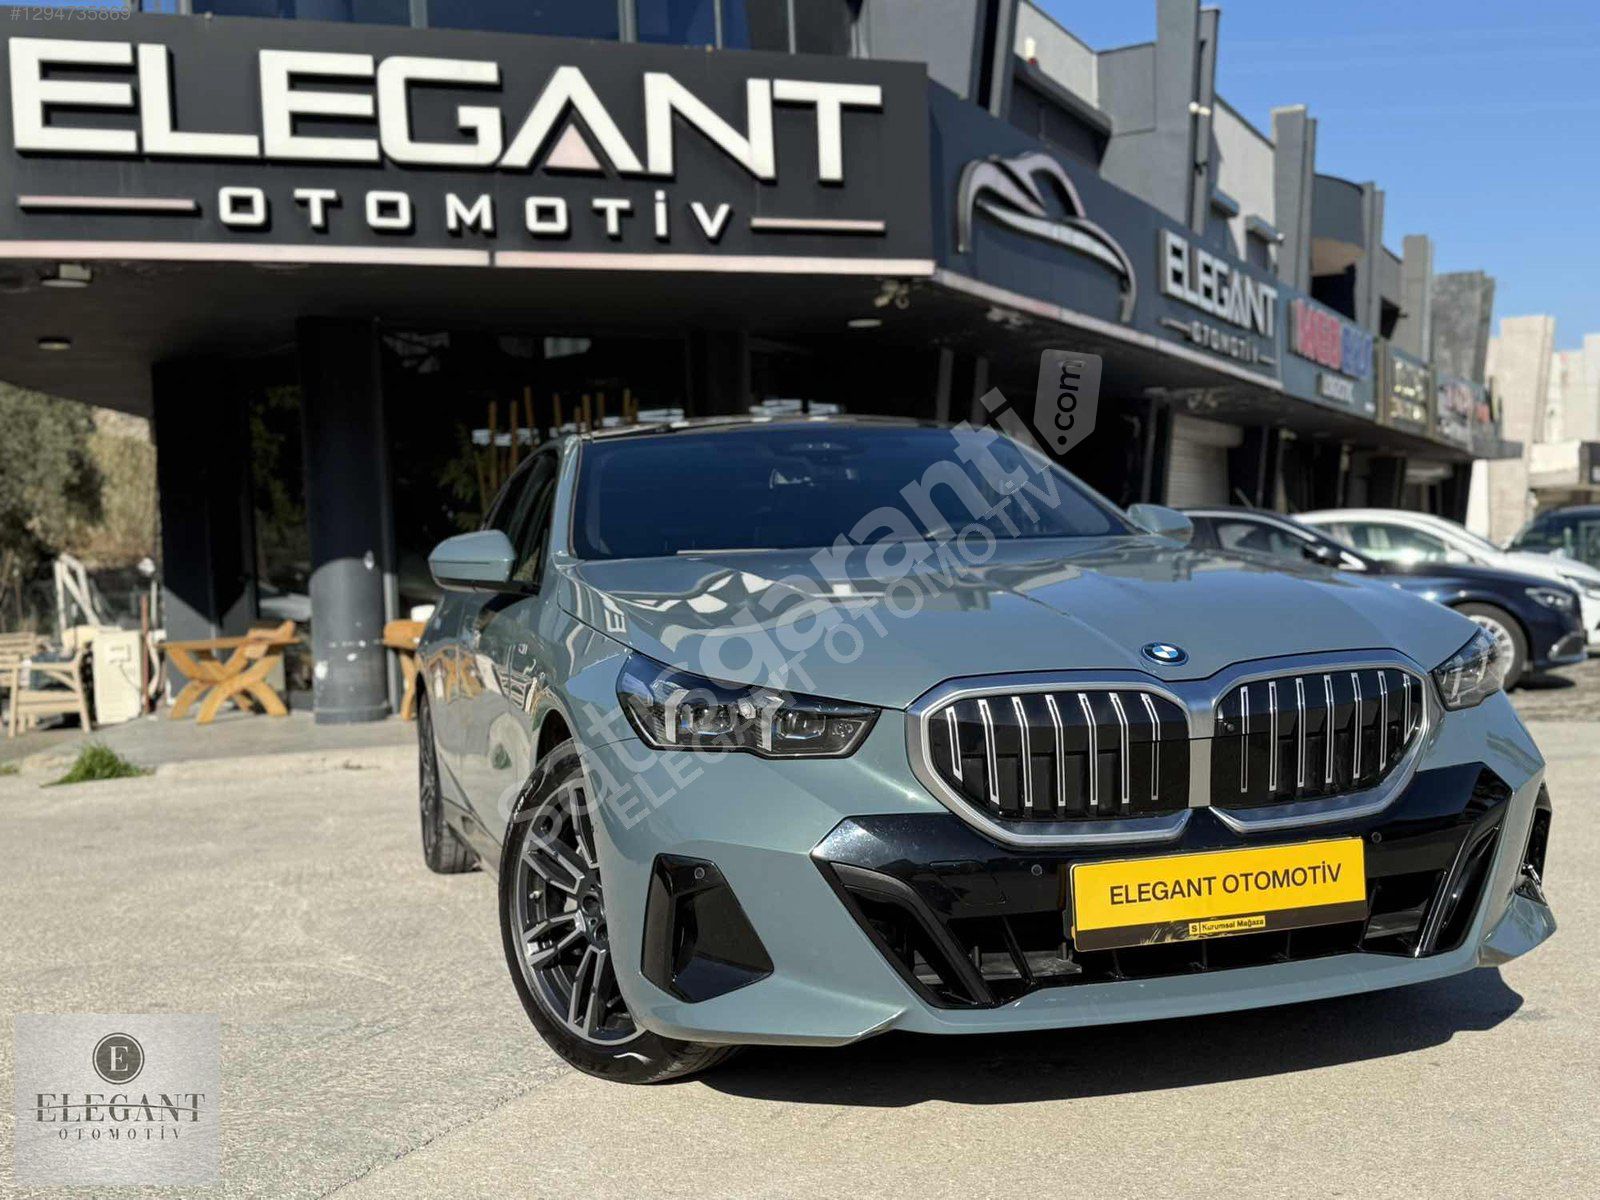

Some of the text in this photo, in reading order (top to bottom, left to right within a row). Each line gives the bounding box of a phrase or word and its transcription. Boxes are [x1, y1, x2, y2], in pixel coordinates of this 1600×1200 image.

[9, 37, 882, 181] ELEGANT
[218, 187, 731, 238] OTOMOTİV
[1163, 229, 1278, 338] ELEGANT
[1110, 860, 1343, 906] ELEGANT OTOMOTİV
